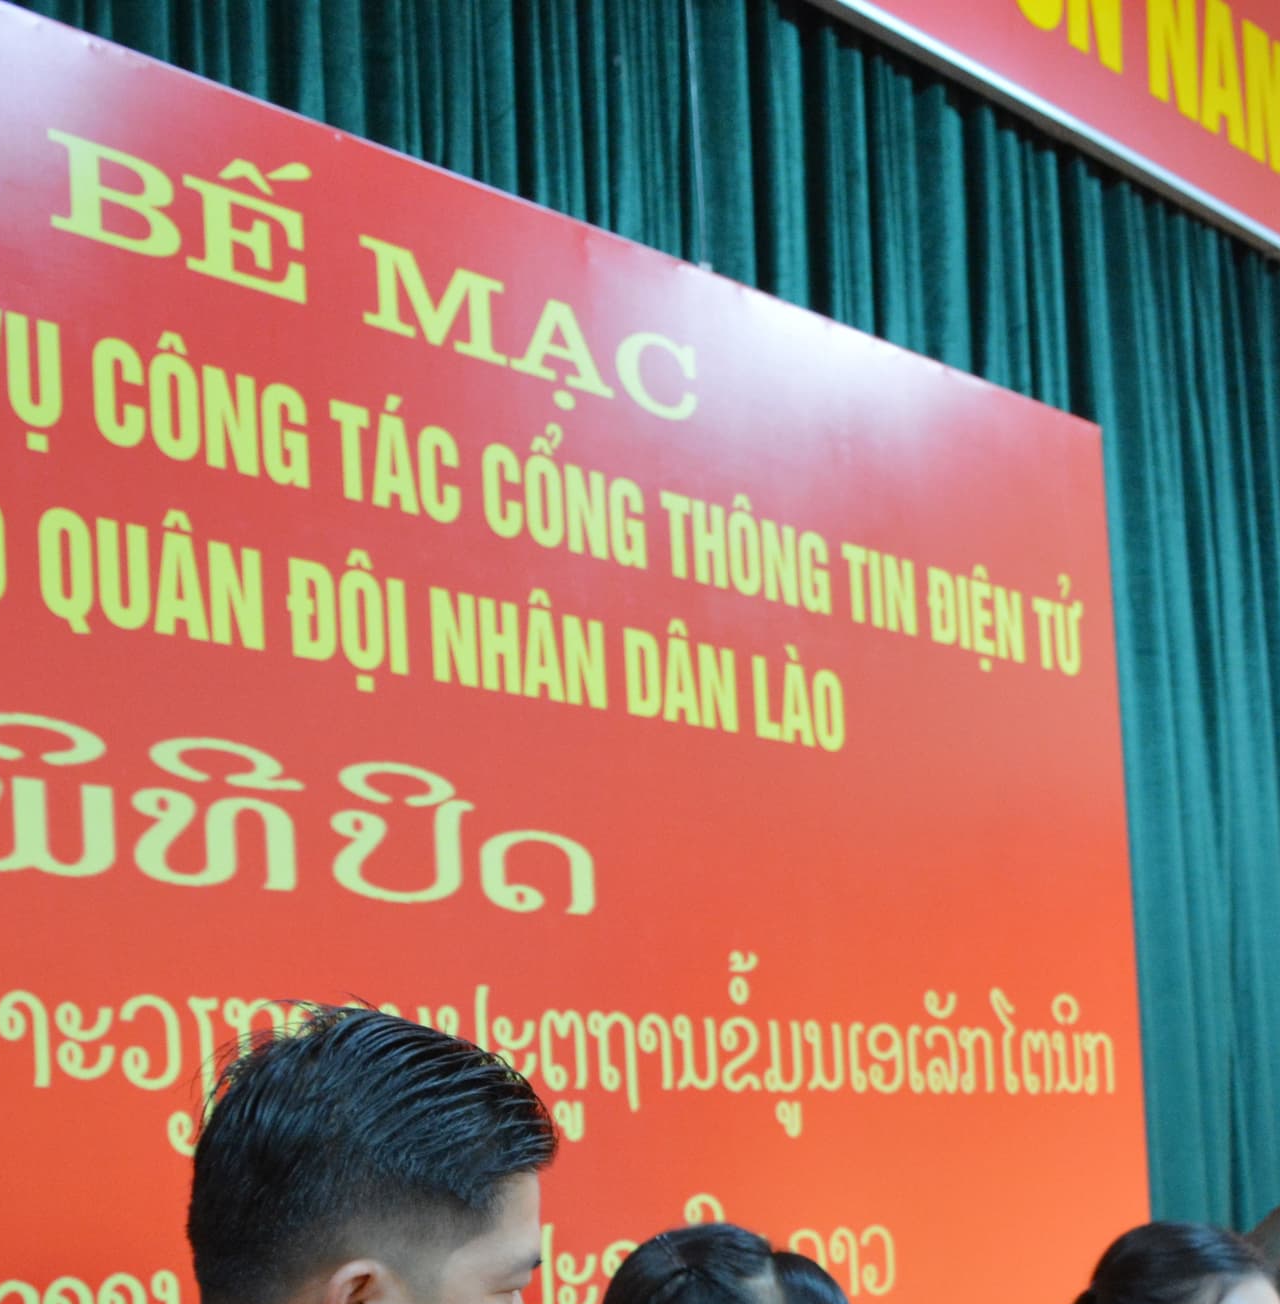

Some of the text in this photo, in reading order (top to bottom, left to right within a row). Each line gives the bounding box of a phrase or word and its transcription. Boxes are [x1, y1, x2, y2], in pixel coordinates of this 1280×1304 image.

[48, 129, 311, 303] BẾ
[360, 235, 697, 419] MẠC
[39, 508, 265, 650] QUÂN
[288, 549, 408, 692] ĐỘI
[430, 587, 608, 709] NHÂN
[624, 619, 739, 732] DÂN
[753, 645, 845, 751] LÀO
[93, 332, 310, 488] CÔNG
[330, 395, 461, 523] TÁC
[483, 424, 647, 568] CỔNG
[661, 492, 832, 615] THÔNG
[842, 543, 918, 635] TIN
[928, 565, 1025, 671] ĐIỆN
[1033, 575, 1083, 676] TỬ
